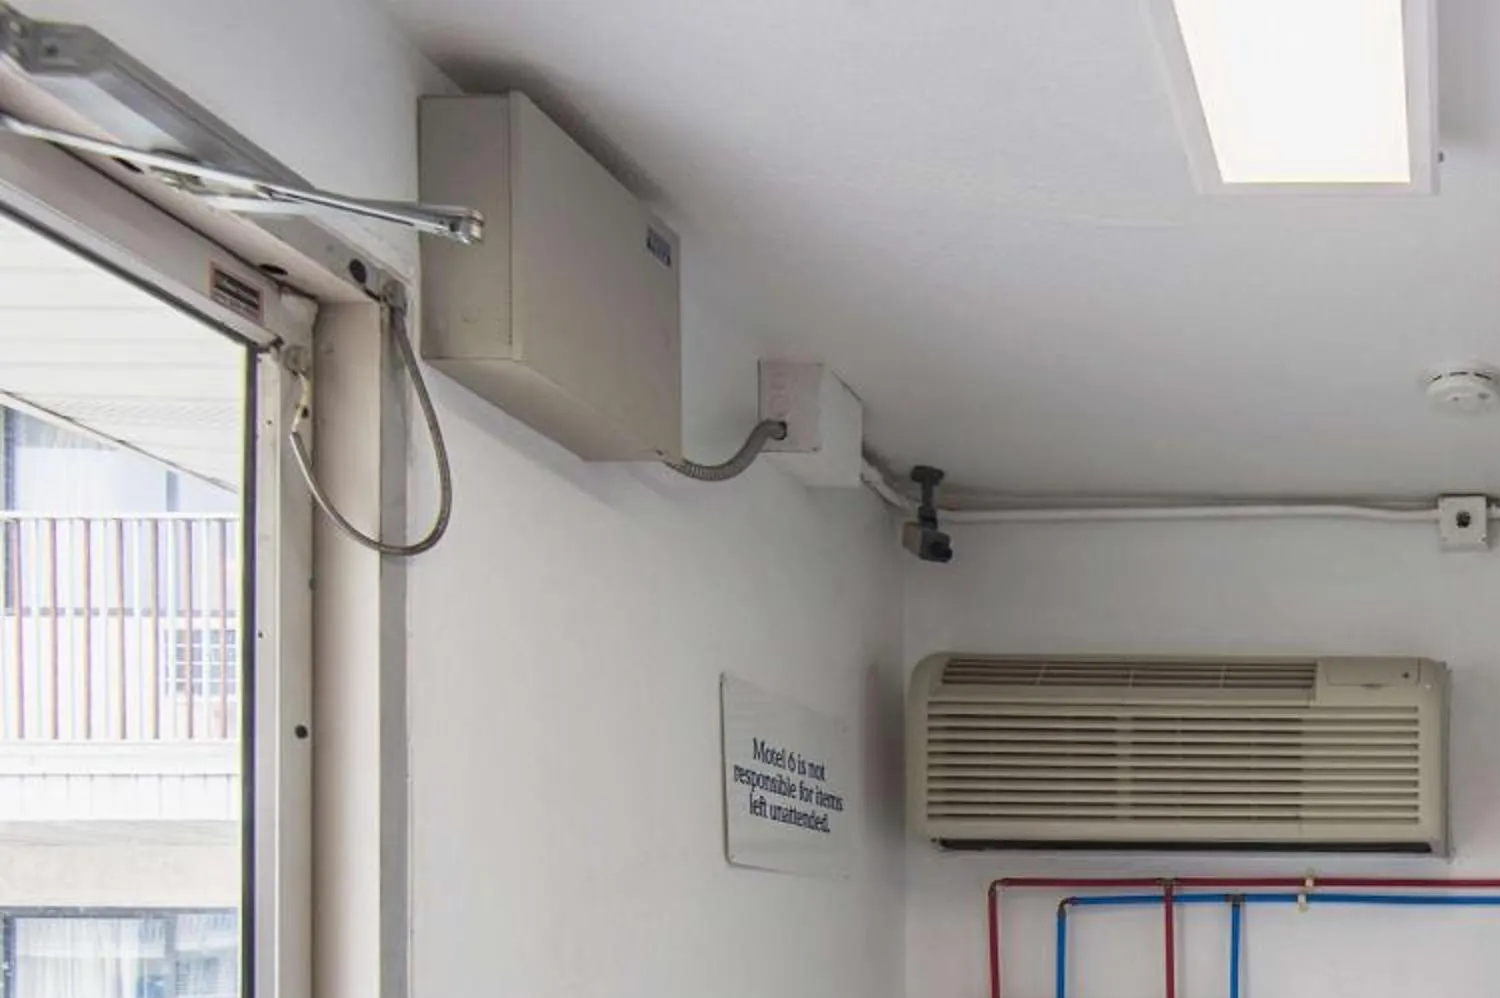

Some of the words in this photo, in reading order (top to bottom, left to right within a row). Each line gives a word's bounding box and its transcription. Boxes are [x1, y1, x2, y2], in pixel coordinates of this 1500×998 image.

[753, 737, 786, 770] Motel
[787, 751, 797, 773] 6
[798, 753, 806, 775] is
[808, 761, 825, 781] not
[733, 764, 797, 799] responsible
[799, 780, 813, 803] for
[815, 785, 844, 812] items
[749, 792, 768, 819] left
[769, 804, 830, 833] unattended.
